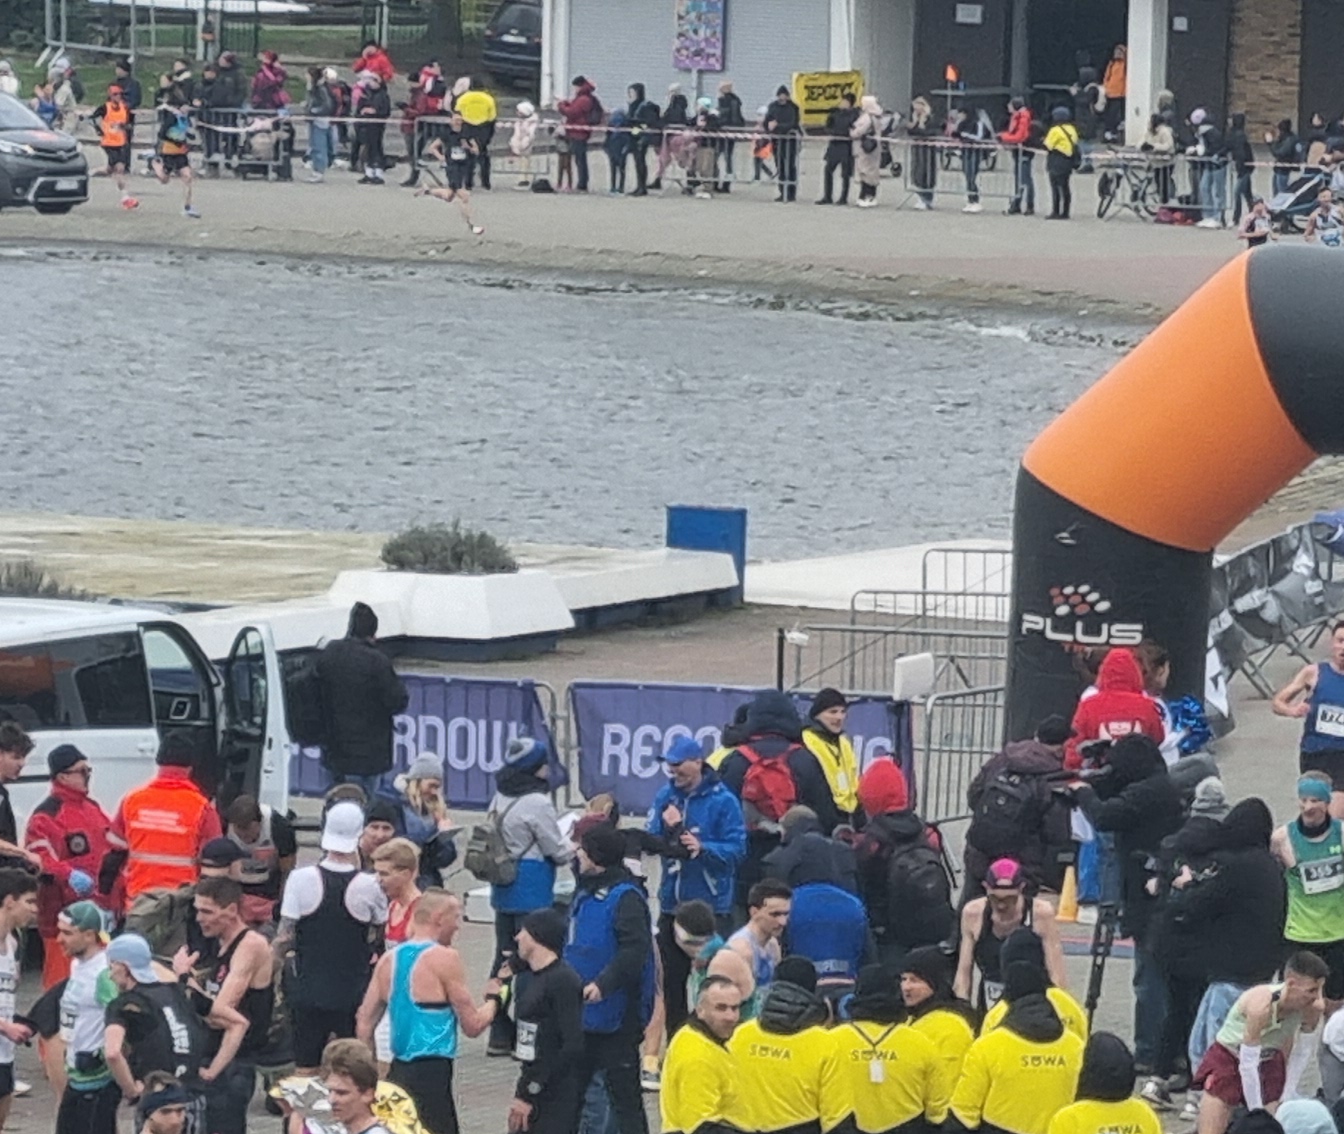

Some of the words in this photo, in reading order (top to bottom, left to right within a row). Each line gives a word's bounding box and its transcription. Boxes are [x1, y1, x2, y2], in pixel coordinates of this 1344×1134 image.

[1021, 613, 1144, 645] PLUS
[748, 1043, 792, 1061] SOWA
[849, 1048, 899, 1062] SOWA
[1020, 1054, 1067, 1068] SOWA
